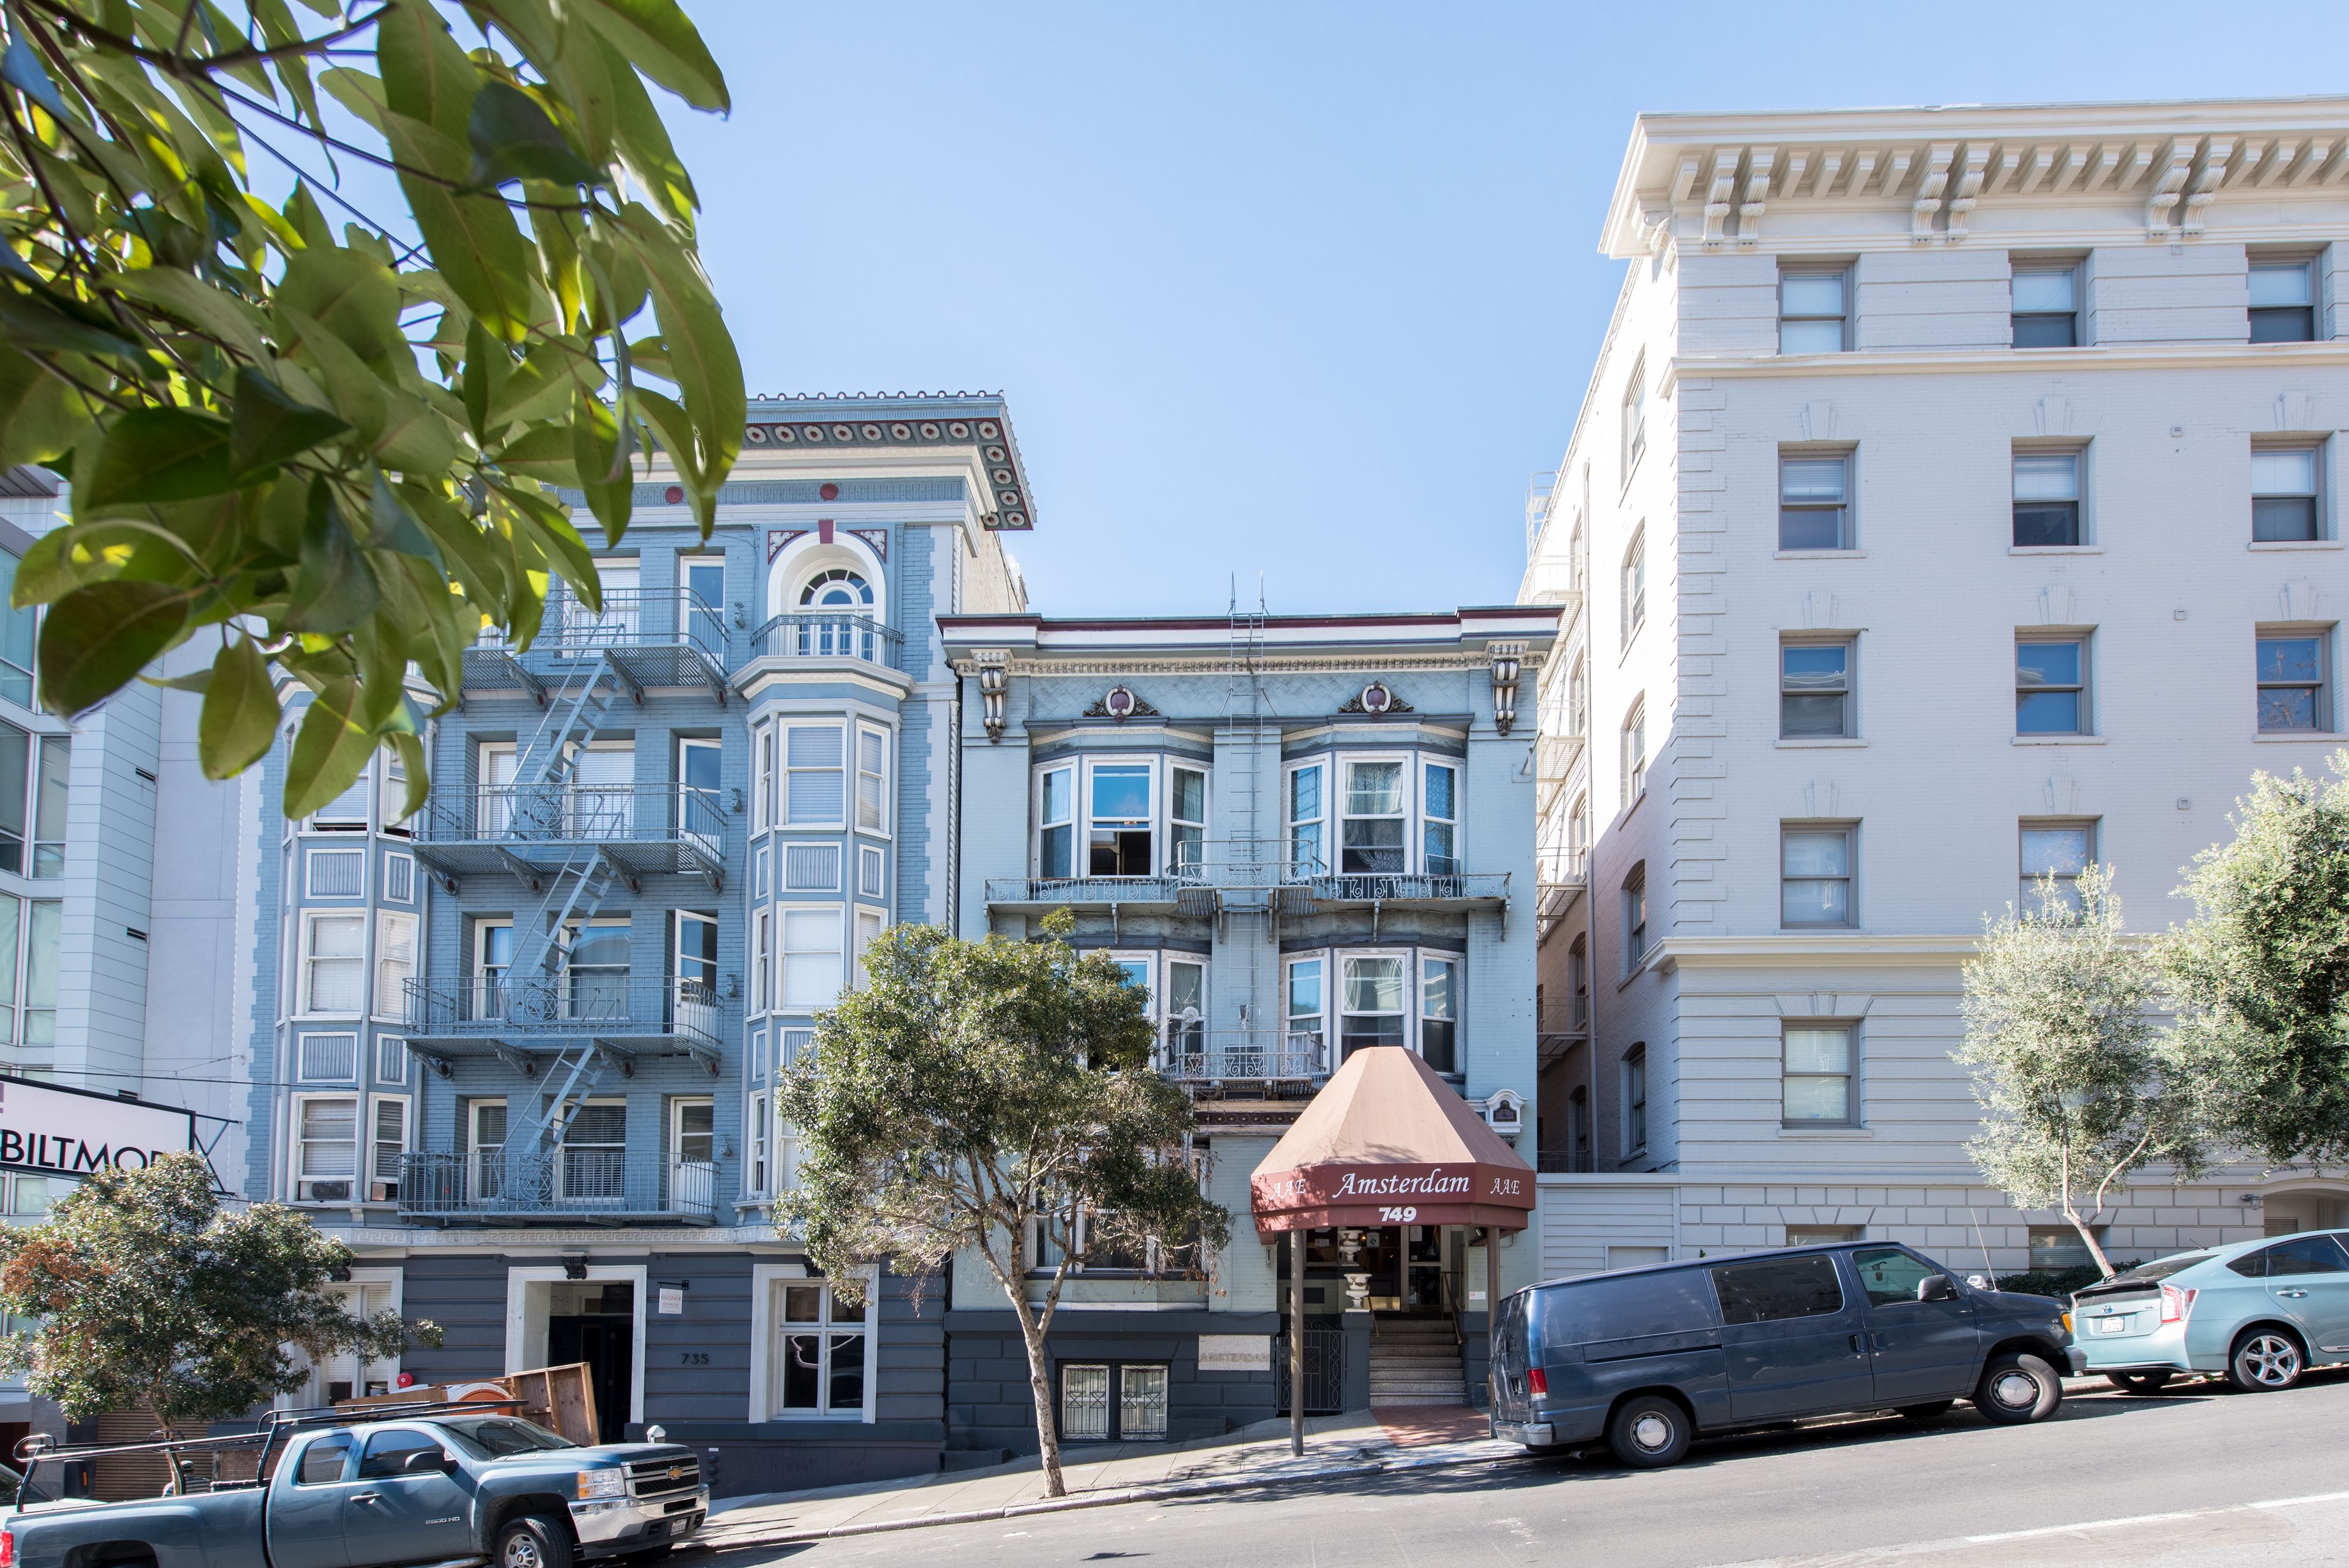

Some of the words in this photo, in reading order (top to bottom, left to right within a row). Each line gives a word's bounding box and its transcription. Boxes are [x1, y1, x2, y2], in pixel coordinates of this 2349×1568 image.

[1269, 1178, 1306, 1200] AAE
[1332, 1168, 1470, 1198] Amsterdam
[1490, 1178, 1520, 1195] AAE
[1379, 1206, 1417, 1222] 749
[681, 1353, 709, 1364] 735
